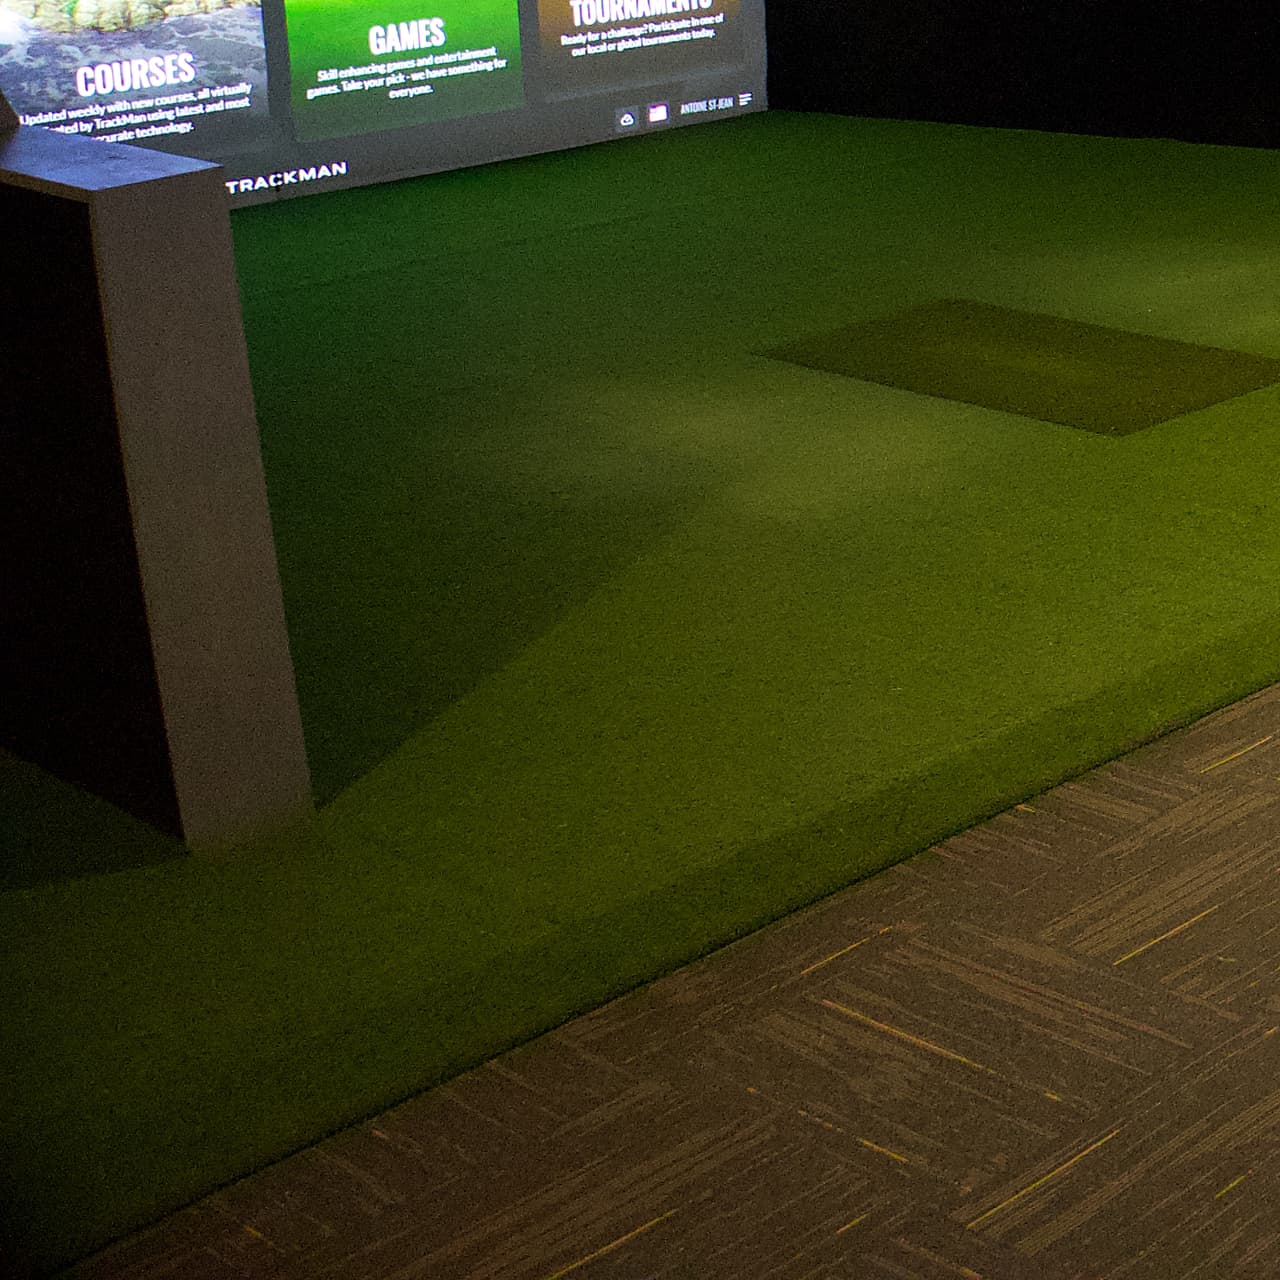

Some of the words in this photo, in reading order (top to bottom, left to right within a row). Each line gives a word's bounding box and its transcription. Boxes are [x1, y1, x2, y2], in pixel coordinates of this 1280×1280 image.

[368, 17, 446, 55] GAMES
[561, 33, 587, 46] Ready
[588, 32, 600, 42] for
[608, 23, 648, 39] challenge?
[649, 19, 690, 33] Participate
[691, 17, 700, 27] in
[700, 16, 715, 26] one
[715, 13, 724, 23] of
[572, 47, 586, 57] our
[588, 42, 607, 54] local
[608, 43, 617, 52] or
[617, 38, 642, 52] global
[643, 32, 692, 46] tournaments
[692, 28, 716, 39] today.
[76, 52, 197, 98] COURSES
[306, 84, 341, 100] games.
[342, 78, 363, 92] Take
[364, 76, 386, 90] your
[386, 72, 406, 87] pick
[410, 72, 426, 82] we
[426, 66, 448, 80] have
[448, 60, 494, 77] something
[494, 58, 508, 70] for
[317, 67, 338, 82] Skill
[338, 61, 386, 79] enhancing
[387, 58, 416, 74] games
[416, 54, 434, 67] and
[434, 46, 498, 64] entertainment
[19, 109, 67, 126] Updated
[68, 103, 106, 118] weekly
[106, 100, 130, 113] with
[131, 98, 154, 110] new
[155, 91, 198, 107] courses,
[198, 87, 210, 100] all
[210, 81, 253, 98] virtually
[389, 83, 434, 100] everyone.
[681, 100, 707, 114] ANTOINE
[79, 120, 94, 133] by
[94, 112, 147, 130] TrackMan
[147, 108, 175, 121] using
[175, 104, 204, 118] latest
[204, 100, 225, 113] and
[225, 96, 252, 110] most
[136, 121, 195, 138] technology.
[225, 161, 348, 195] TRACKMAN
